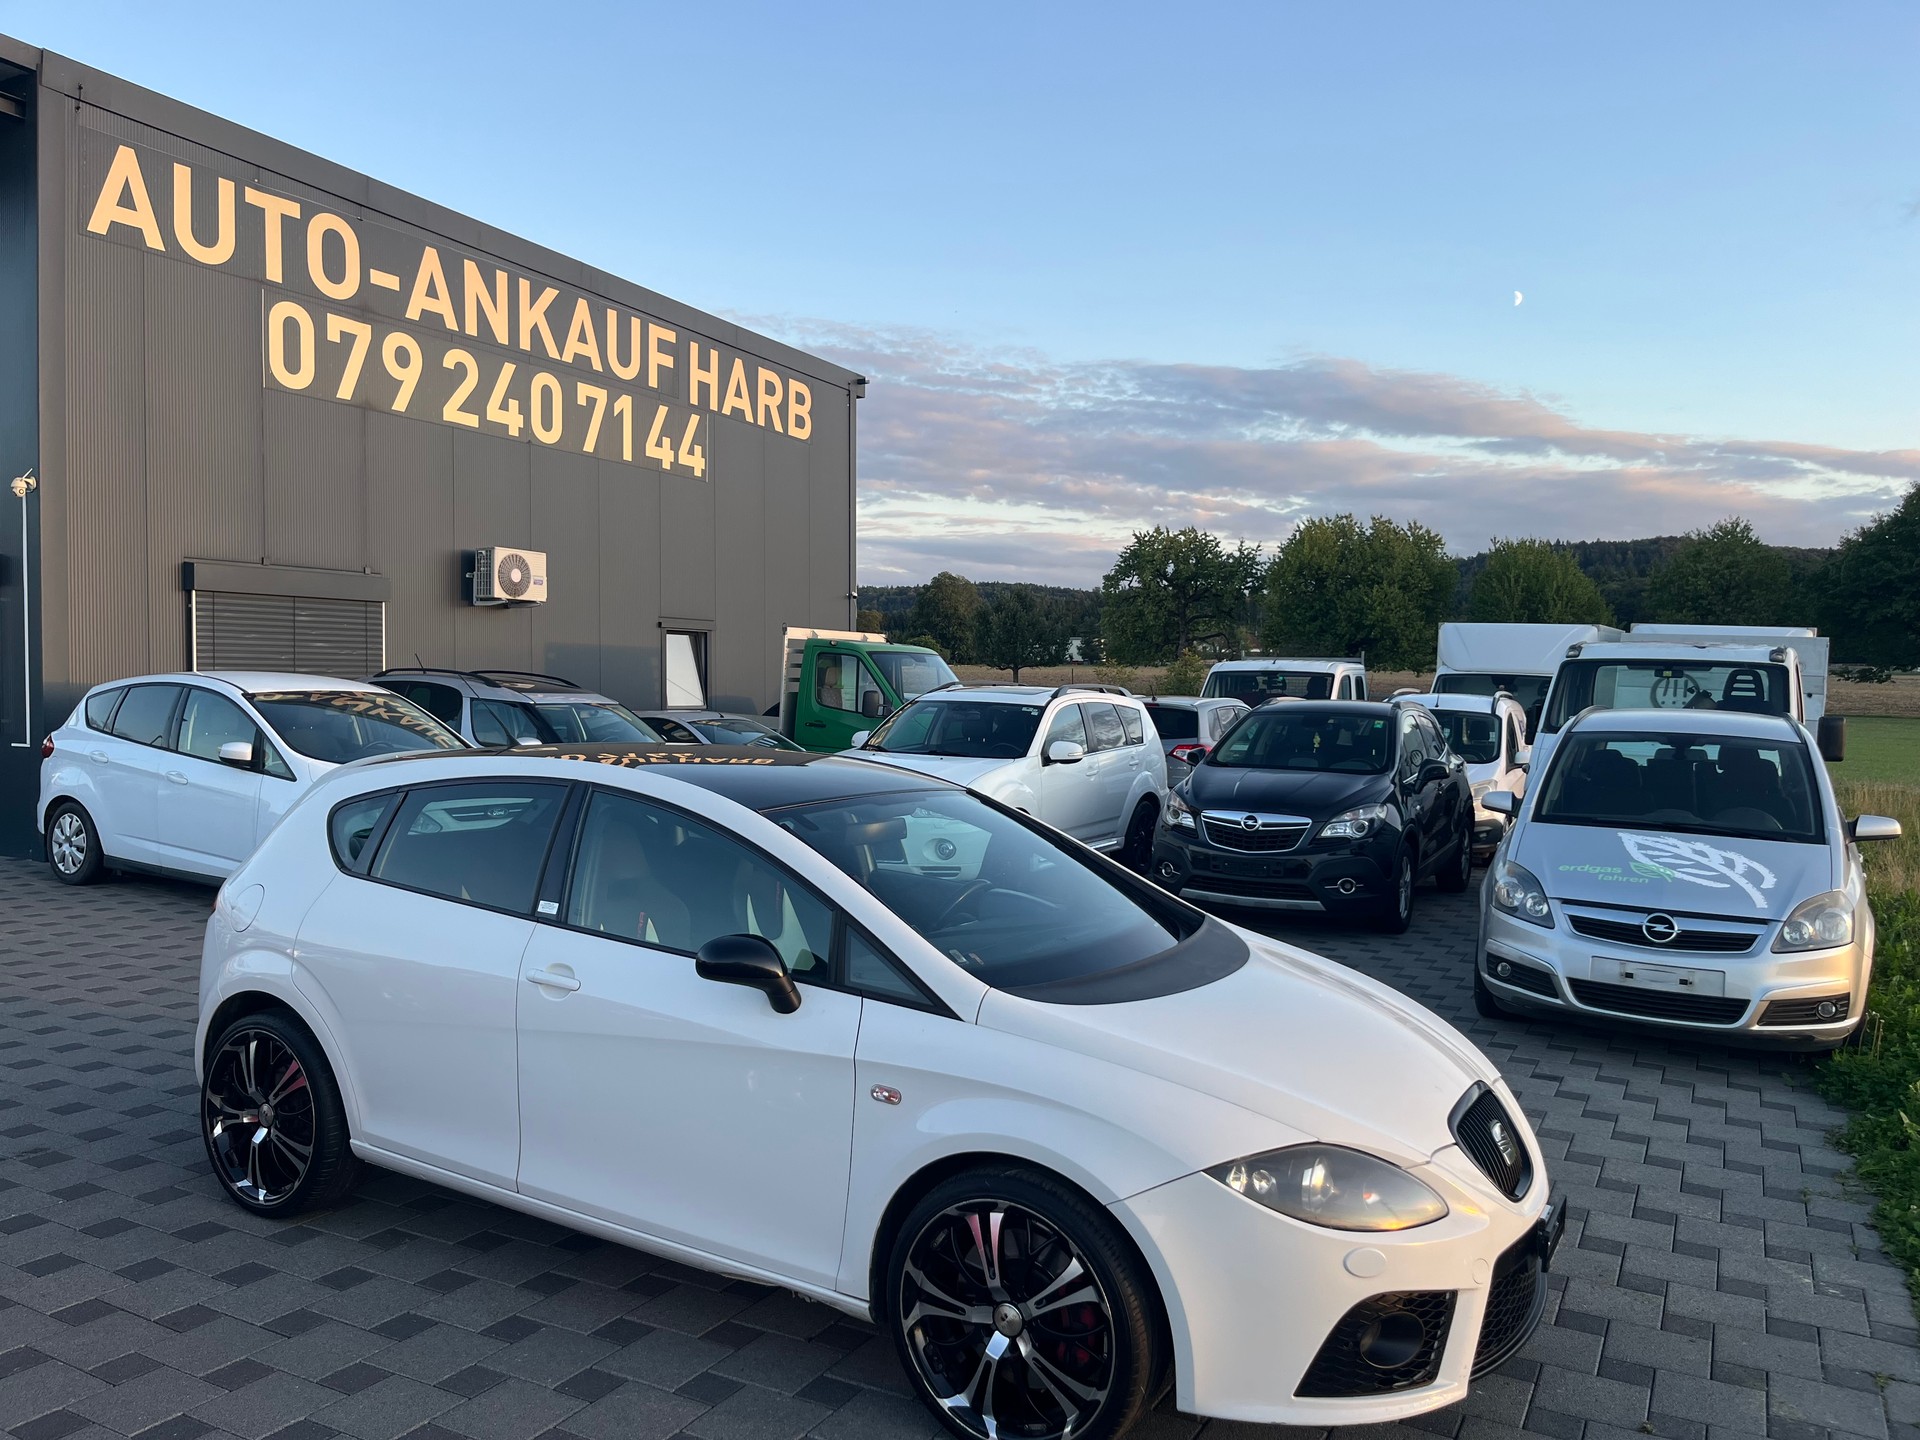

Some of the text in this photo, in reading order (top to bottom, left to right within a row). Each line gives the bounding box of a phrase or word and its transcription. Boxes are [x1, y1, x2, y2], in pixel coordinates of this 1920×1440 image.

[87, 144, 812, 440] AUTO-ANKAUF HARB
[268, 301, 706, 477] 079 240 71 44
[1557, 863, 1622, 874] erdgas
[1597, 872, 1649, 884] fahren
